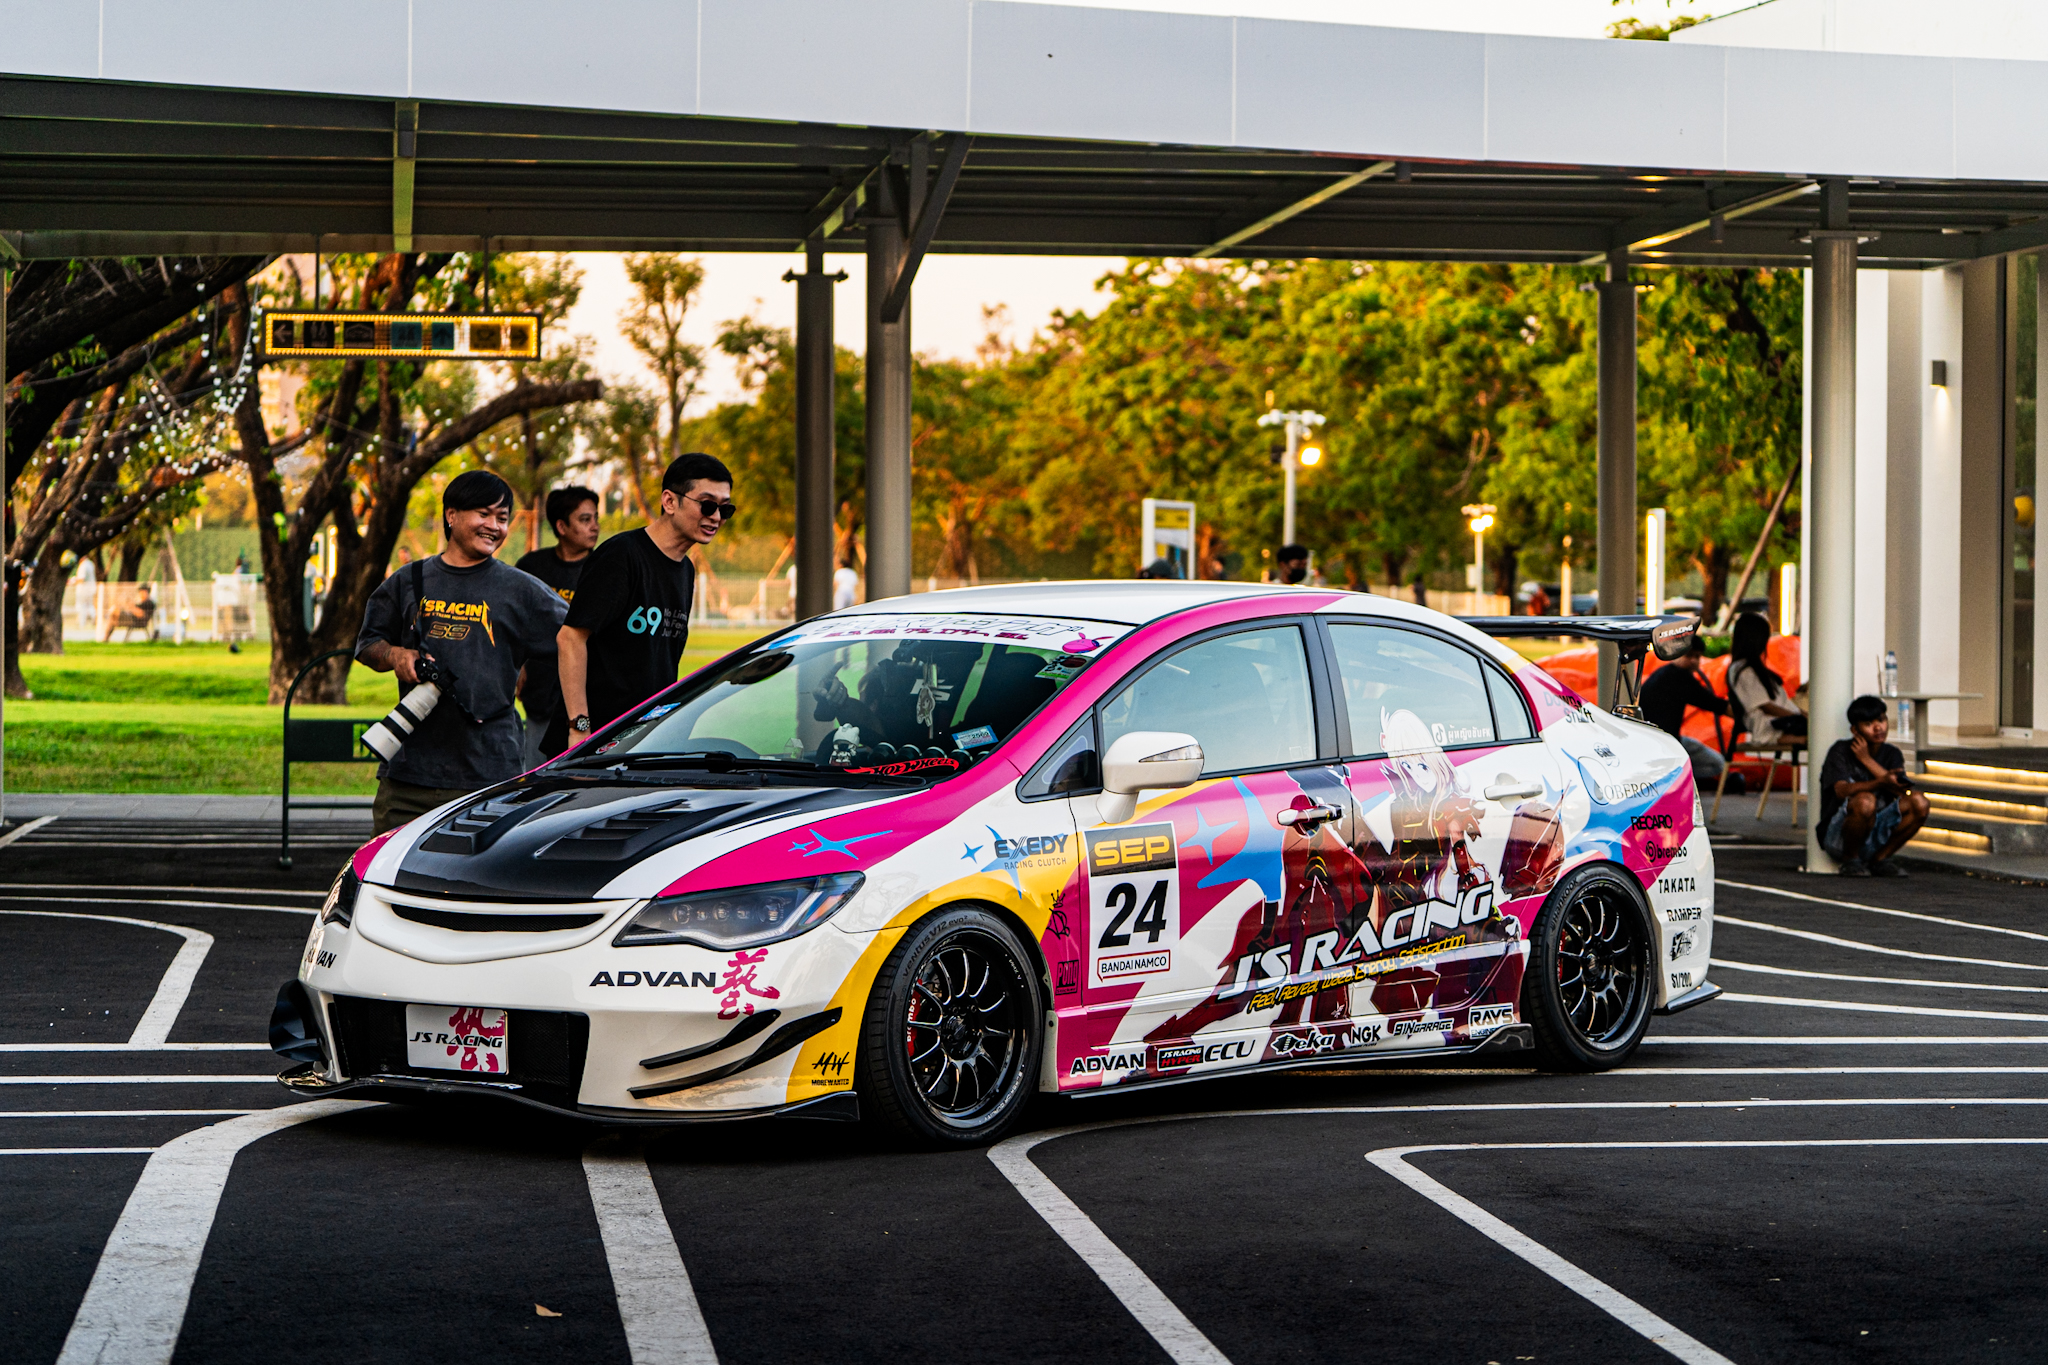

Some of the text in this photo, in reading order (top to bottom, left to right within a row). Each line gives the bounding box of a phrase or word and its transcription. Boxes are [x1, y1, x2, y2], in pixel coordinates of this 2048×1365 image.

[627, 606, 662, 636] 69
[1669, 624, 1694, 636] RACING
[1604, 782, 1660, 801] OBERON
[1630, 814, 1673, 830] RECARO
[994, 834, 1069, 860] EXEDY
[1094, 835, 1170, 867] SEP
[1656, 843, 1688, 859] brembo
[1004, 857, 1067, 870] RACING CLUTCH
[1658, 877, 1696, 894] TAKATA
[1098, 879, 1169, 949] 24
[1666, 907, 1702, 922] RAMPER
[1218, 881, 1494, 1000] J'S RACING
[305, 948, 337, 969] AVAN
[1101, 956, 1167, 973] BANDAI NAMCO
[589, 971, 716, 988] ADVAN
[1470, 1008, 1513, 1027] RAYS
[410, 1031, 503, 1049] J'S RACING
[1352, 1024, 1382, 1044] NGK
[1173, 1047, 1202, 1057] RACING
[1204, 1039, 1256, 1062] ECU
[1071, 1053, 1145, 1075] ADVAN
[1161, 1055, 1201, 1067] HYPER
